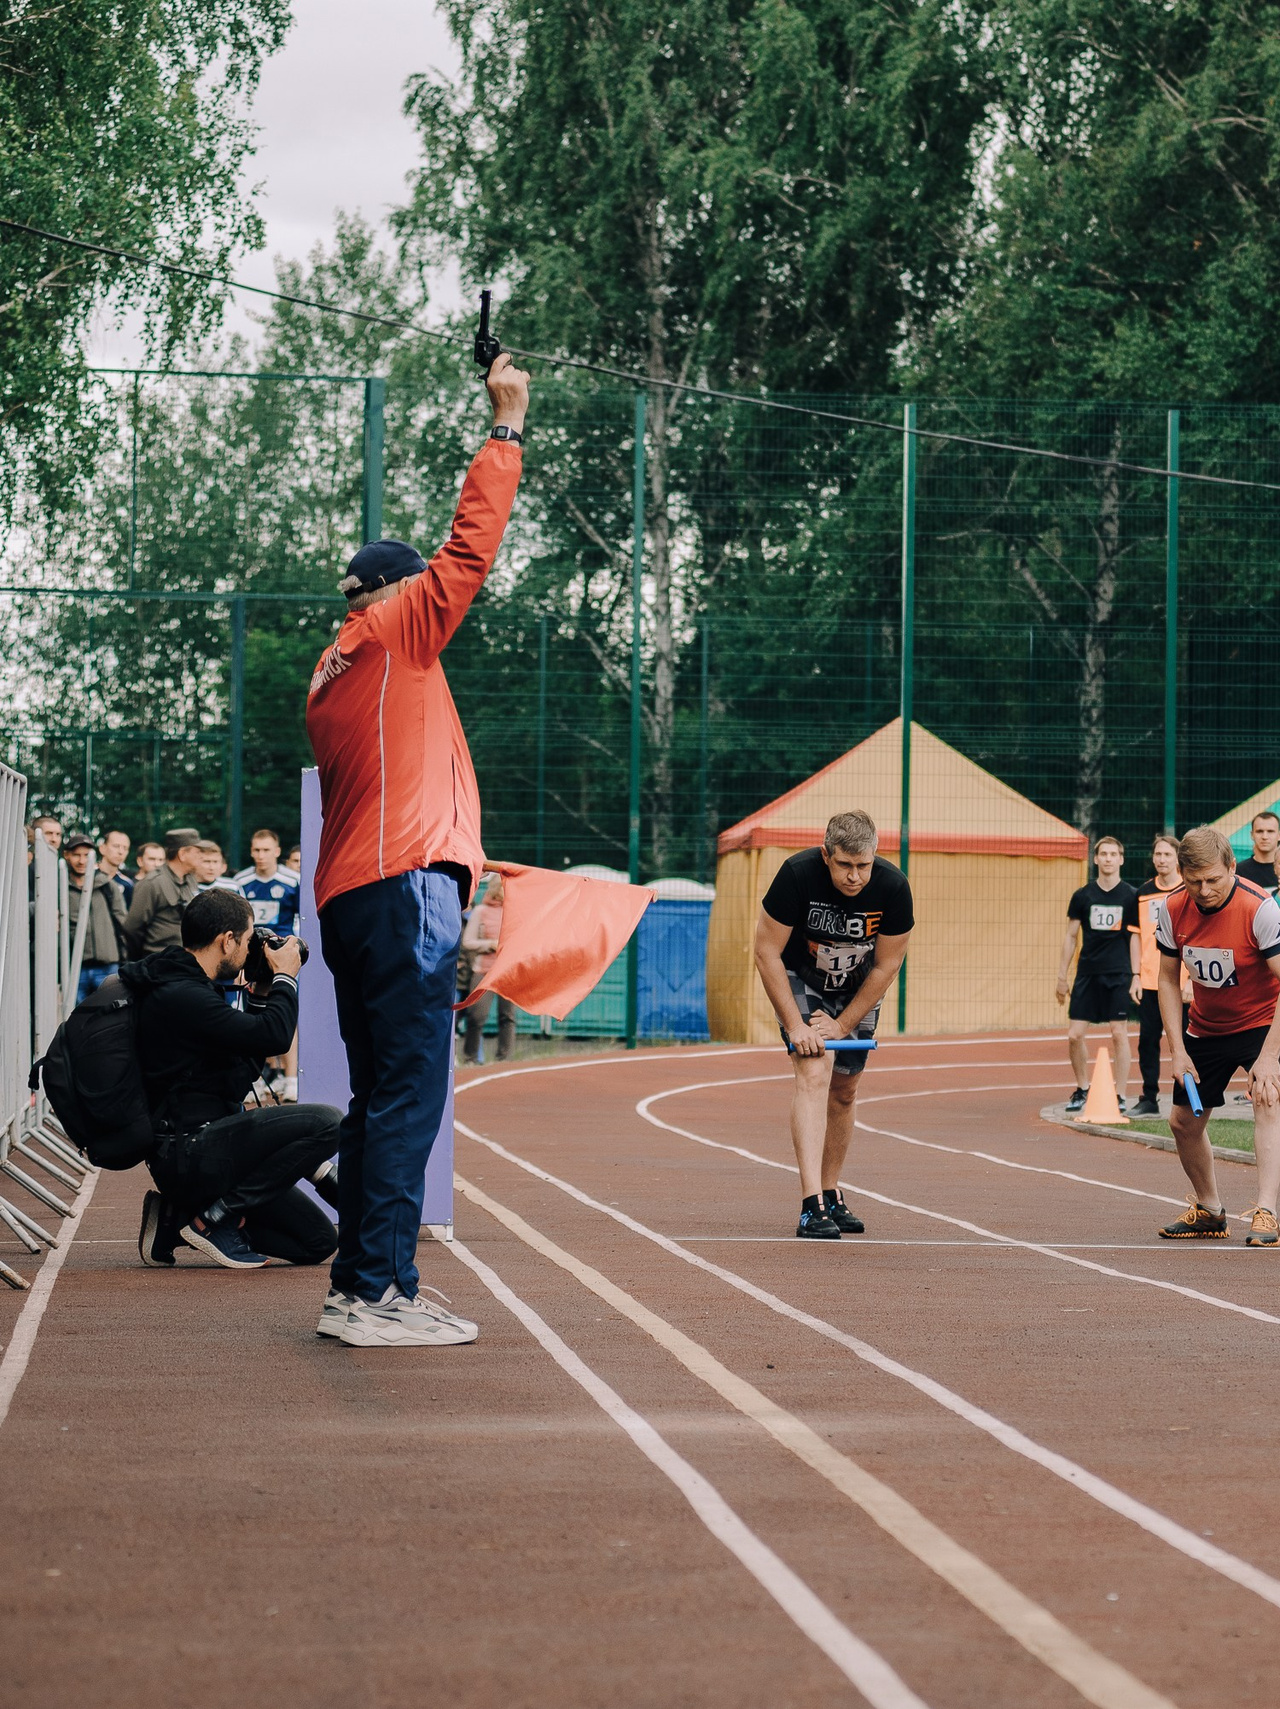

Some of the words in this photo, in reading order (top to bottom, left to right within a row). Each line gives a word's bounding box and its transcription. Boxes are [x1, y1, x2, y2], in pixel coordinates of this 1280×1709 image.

[1096, 913, 1115, 927] 10
[828, 953, 859, 972] 11
[1194, 959, 1224, 983] 10
[1229, 977, 1235, 986] 1
